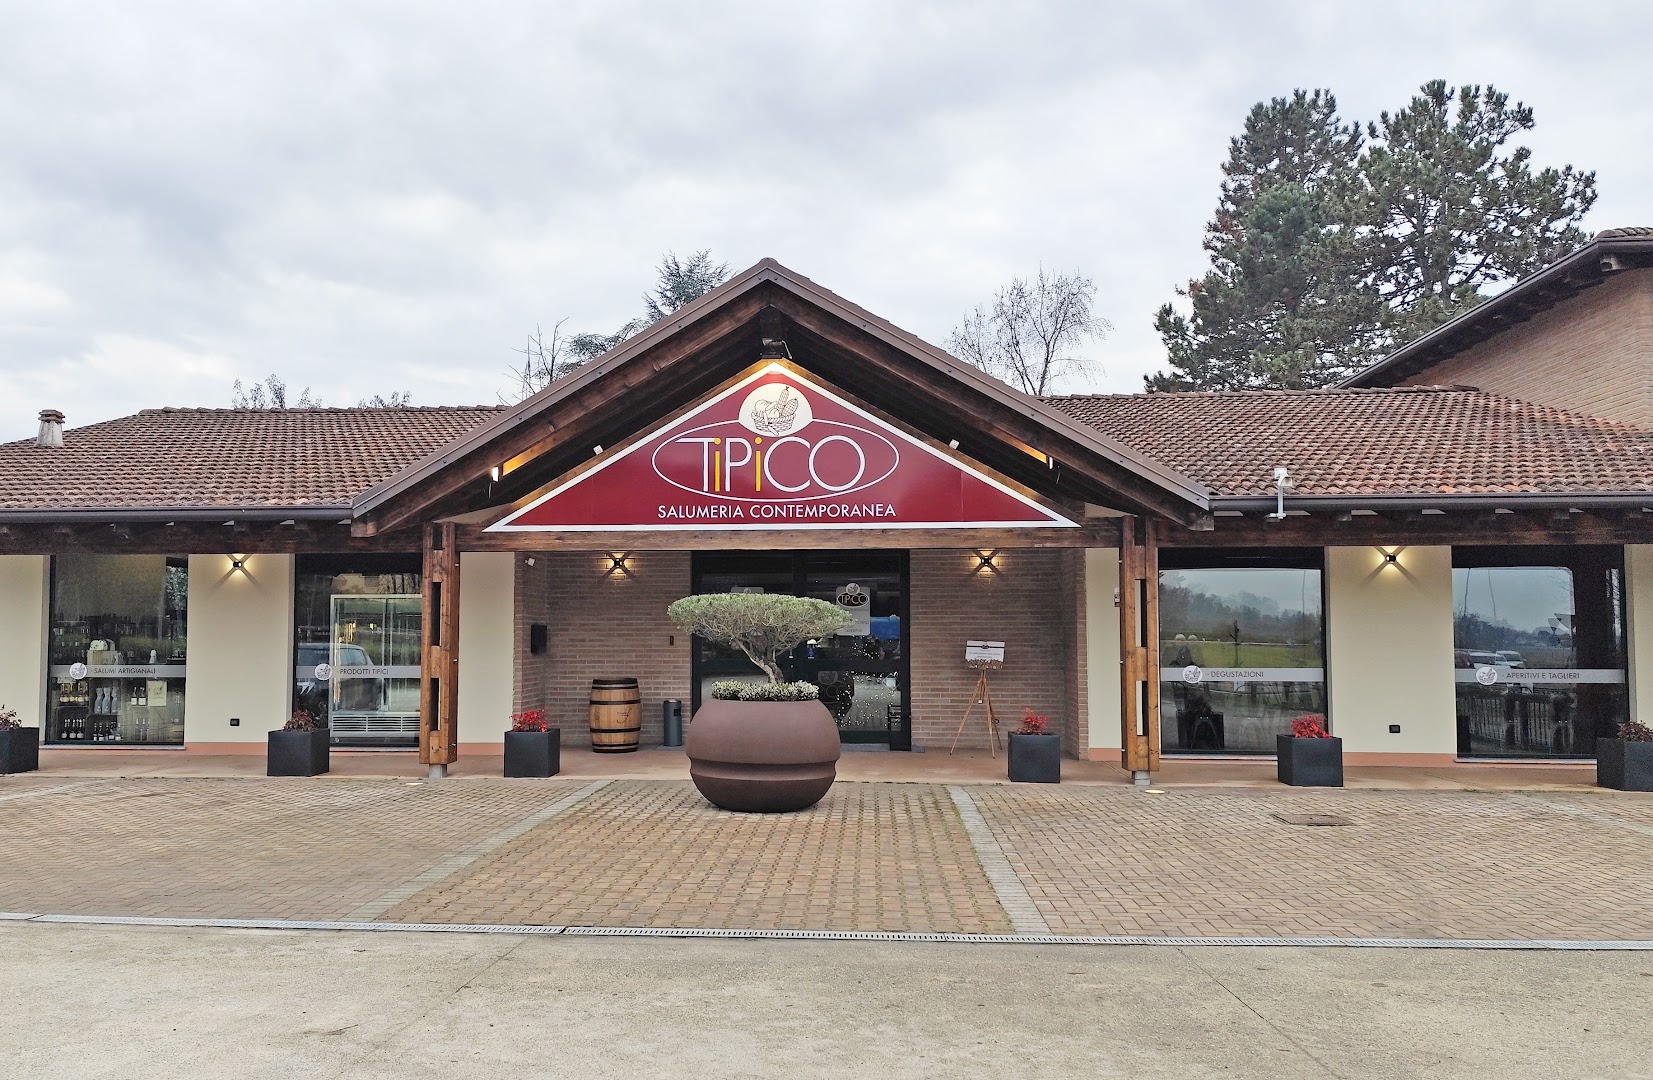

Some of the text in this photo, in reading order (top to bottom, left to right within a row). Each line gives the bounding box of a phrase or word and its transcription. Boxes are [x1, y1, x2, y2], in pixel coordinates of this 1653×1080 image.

[658, 504, 896, 518] SALUMERIA CONTEMPORANEA
[1210, 670, 1264, 678] DEGUSTAZIONI
[1506, 672, 1540, 680] APERITIVI
[1548, 672, 1580, 680] TAGLIERI
